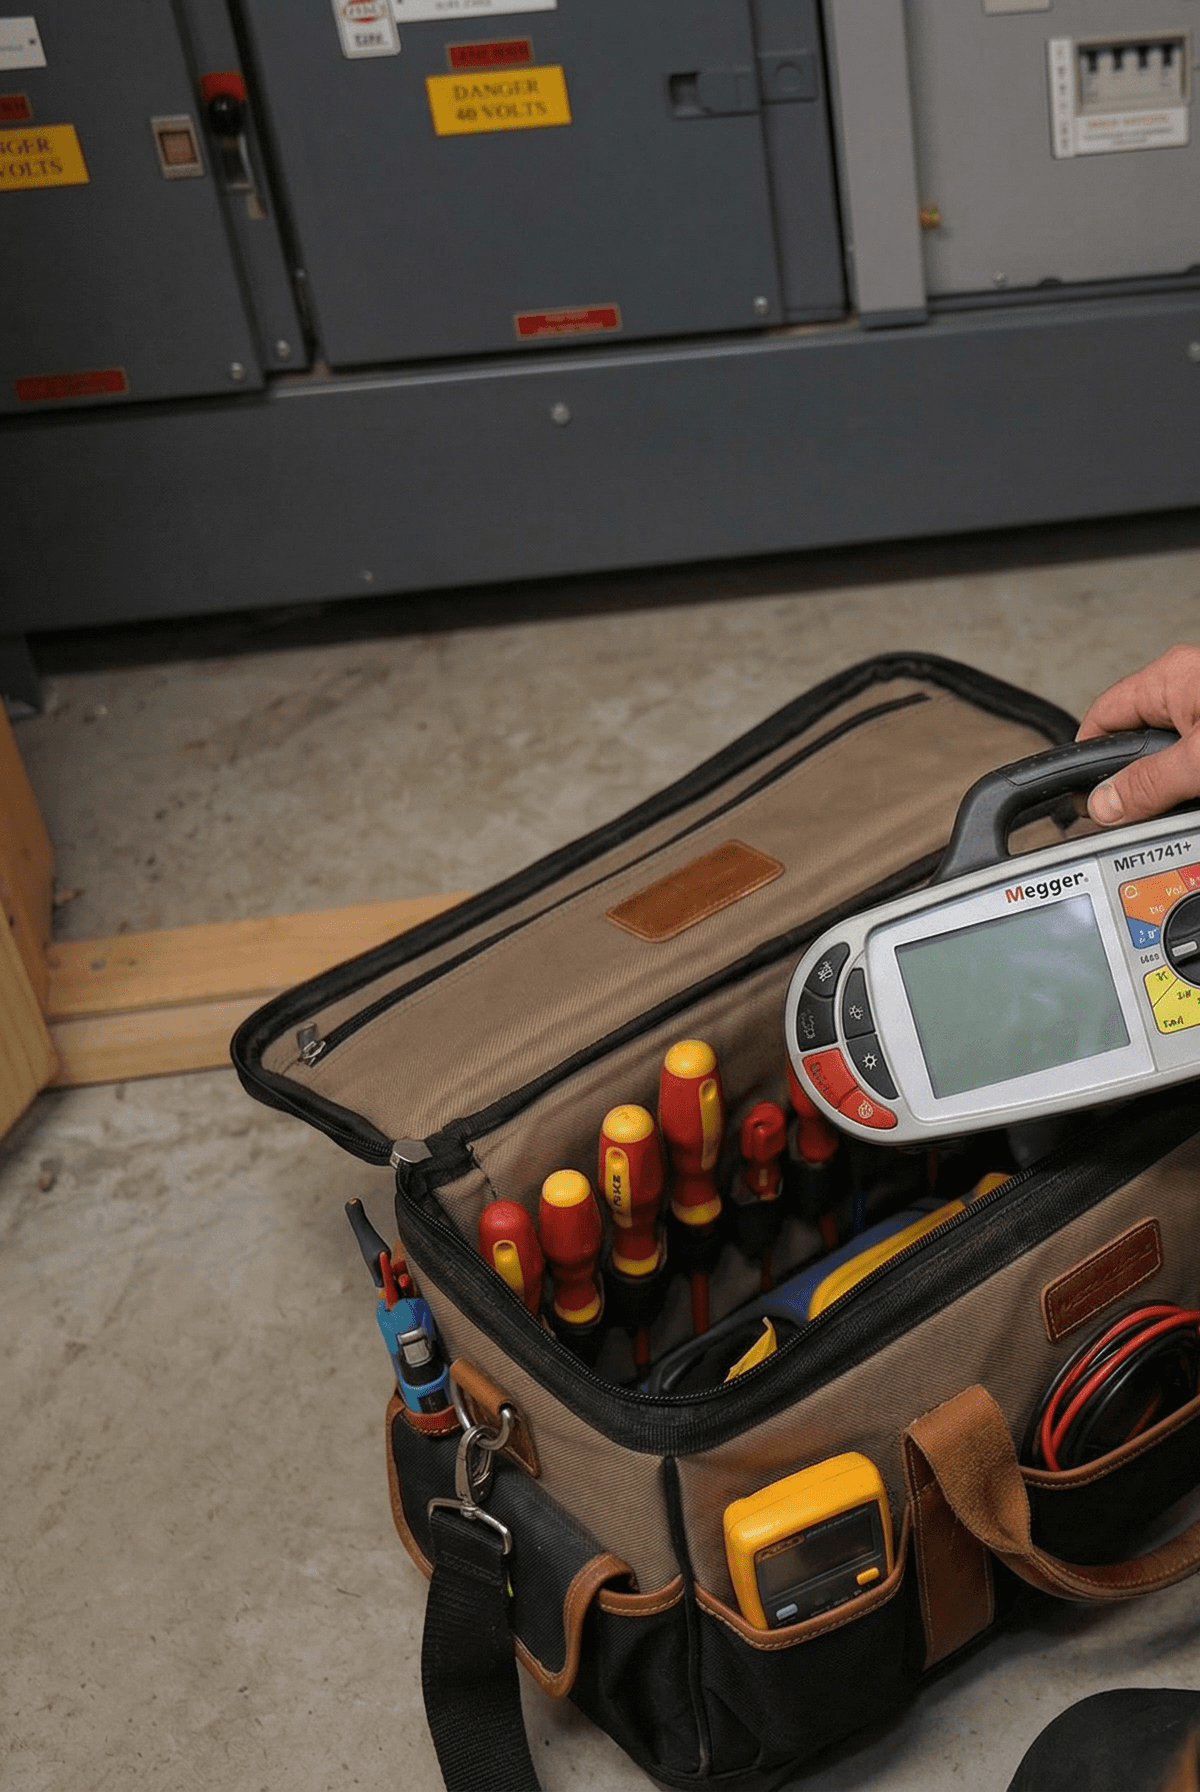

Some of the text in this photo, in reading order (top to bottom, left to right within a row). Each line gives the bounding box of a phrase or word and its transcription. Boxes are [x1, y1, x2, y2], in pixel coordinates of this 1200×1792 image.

[452, 78, 540, 102] DANGER
[481, 101, 548, 121] VOLTS
[1113, 841, 1192, 872] MFT1741+
[1005, 871, 1085, 904] Megger
